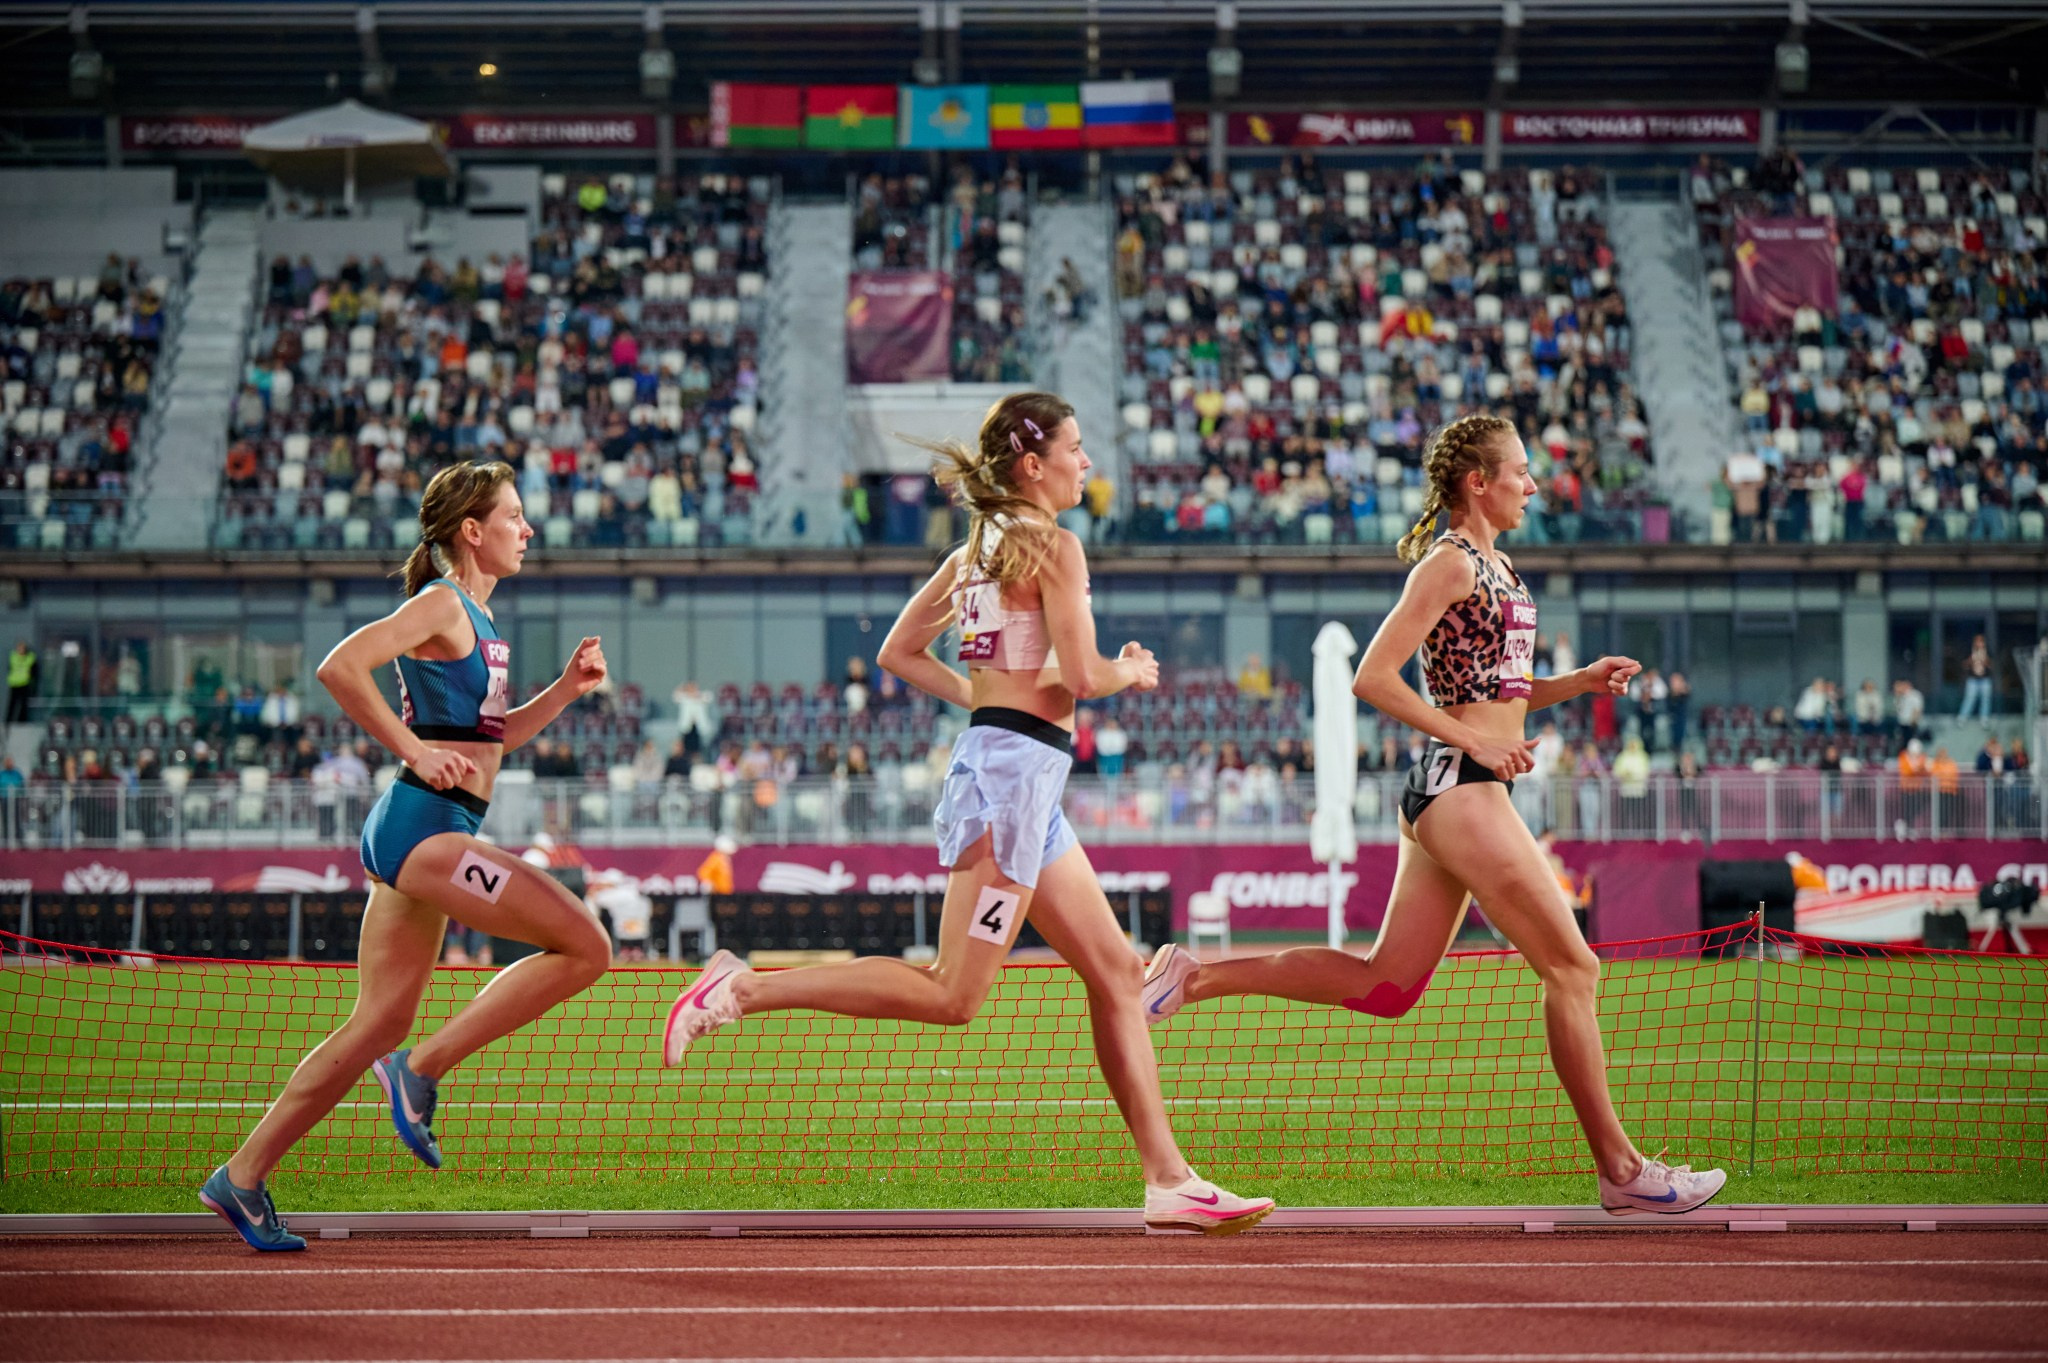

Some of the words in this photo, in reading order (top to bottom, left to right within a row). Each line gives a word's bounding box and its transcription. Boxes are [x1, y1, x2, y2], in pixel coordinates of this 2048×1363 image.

[473, 120, 636, 143] EKATERINBURG
[1513, 115, 1646, 137] ВОСТОЧНАЯ
[1648, 115, 1746, 137] ТРИБУНА
[1435, 755, 1454, 786] 7
[464, 863, 501, 894] 2
[1211, 871, 1359, 908] FONBET
[1825, 863, 1978, 893] РОЛЕВА
[979, 900, 1005, 934] 4
